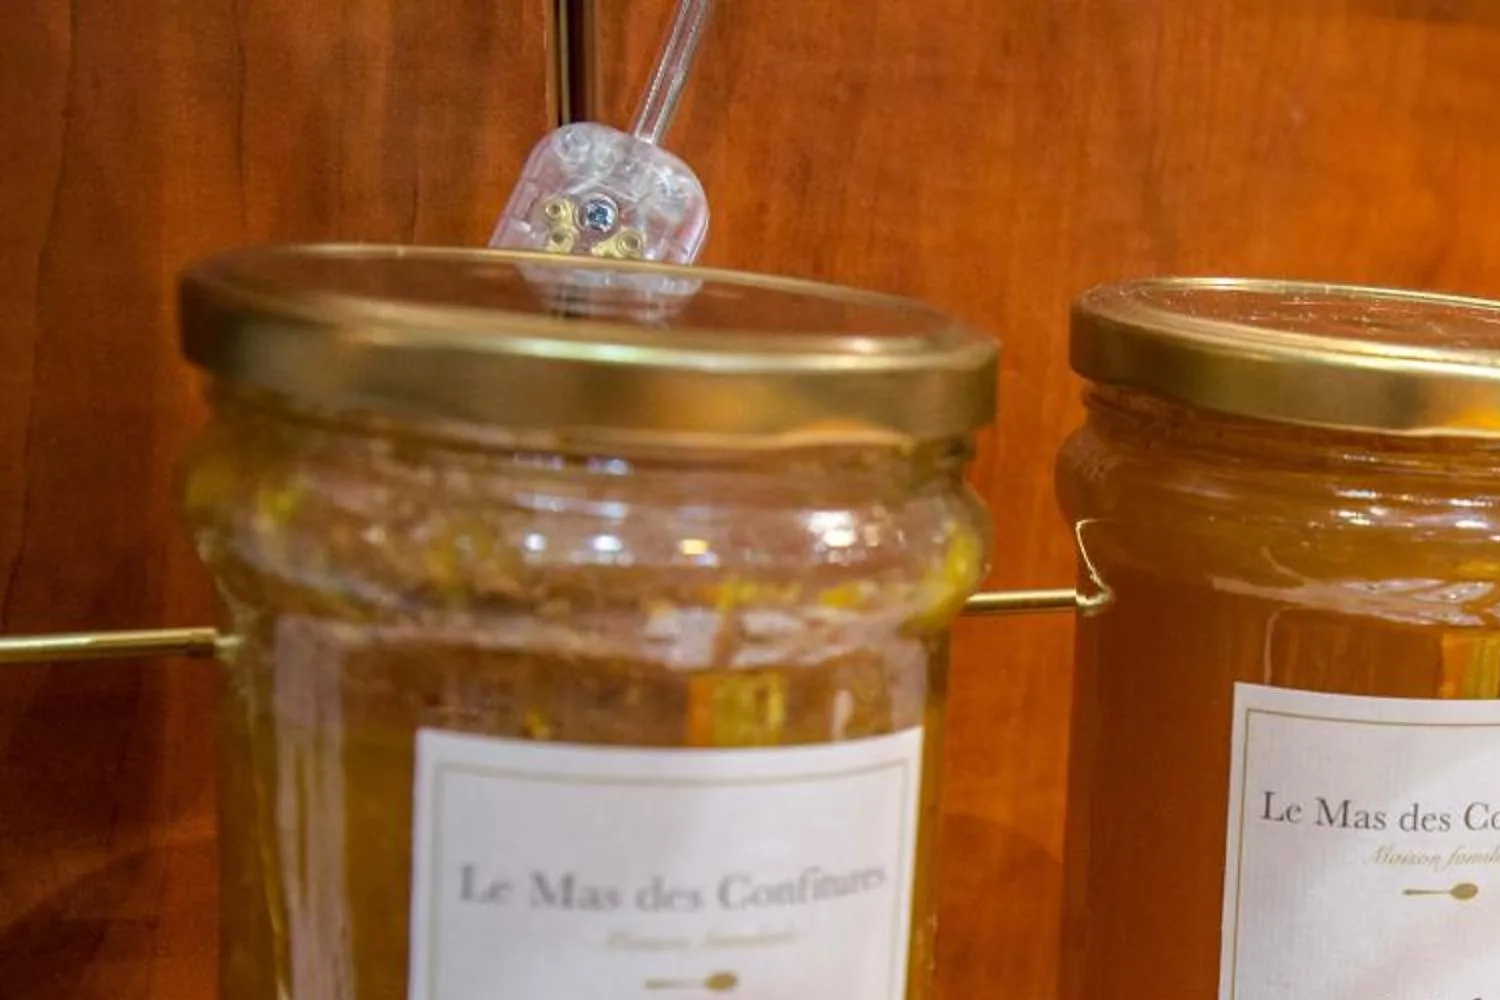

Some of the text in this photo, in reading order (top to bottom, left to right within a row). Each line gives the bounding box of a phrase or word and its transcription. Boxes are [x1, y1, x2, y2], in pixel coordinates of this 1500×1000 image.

[1260, 790, 1303, 824] Le
[1315, 797, 1387, 831] Mas
[1399, 803, 1451, 833] des
[459, 864, 886, 913] Le Mas des Confitures
